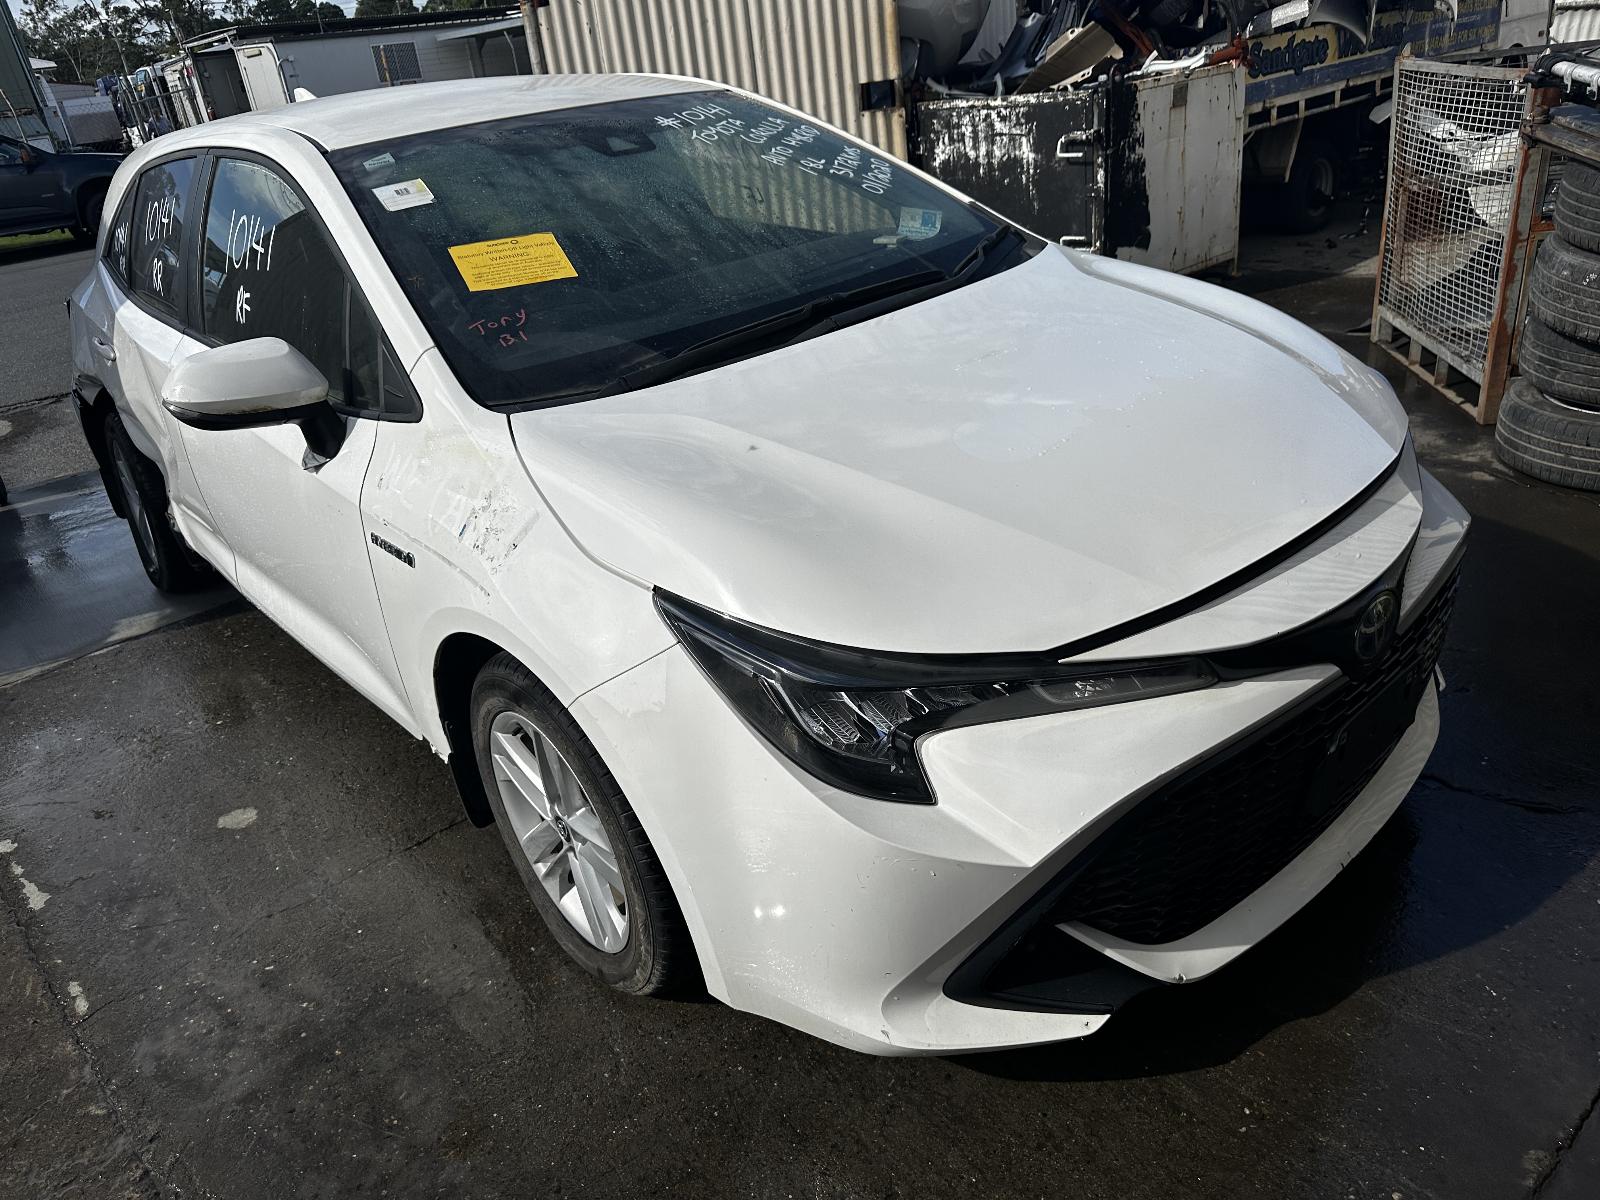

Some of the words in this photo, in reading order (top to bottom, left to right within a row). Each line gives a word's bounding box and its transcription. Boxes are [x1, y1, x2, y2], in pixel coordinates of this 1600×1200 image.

[1248, 33, 1330, 78] Sandgate
[691, 118, 746, 145] TOYOTA
[760, 146, 794, 167] AUTO
[145, 196, 176, 245] 10141
[225, 208, 276, 273] 10141
[489, 251, 530, 262] WARNING
[152, 257, 164, 296] RR
[235, 284, 251, 324] RF
